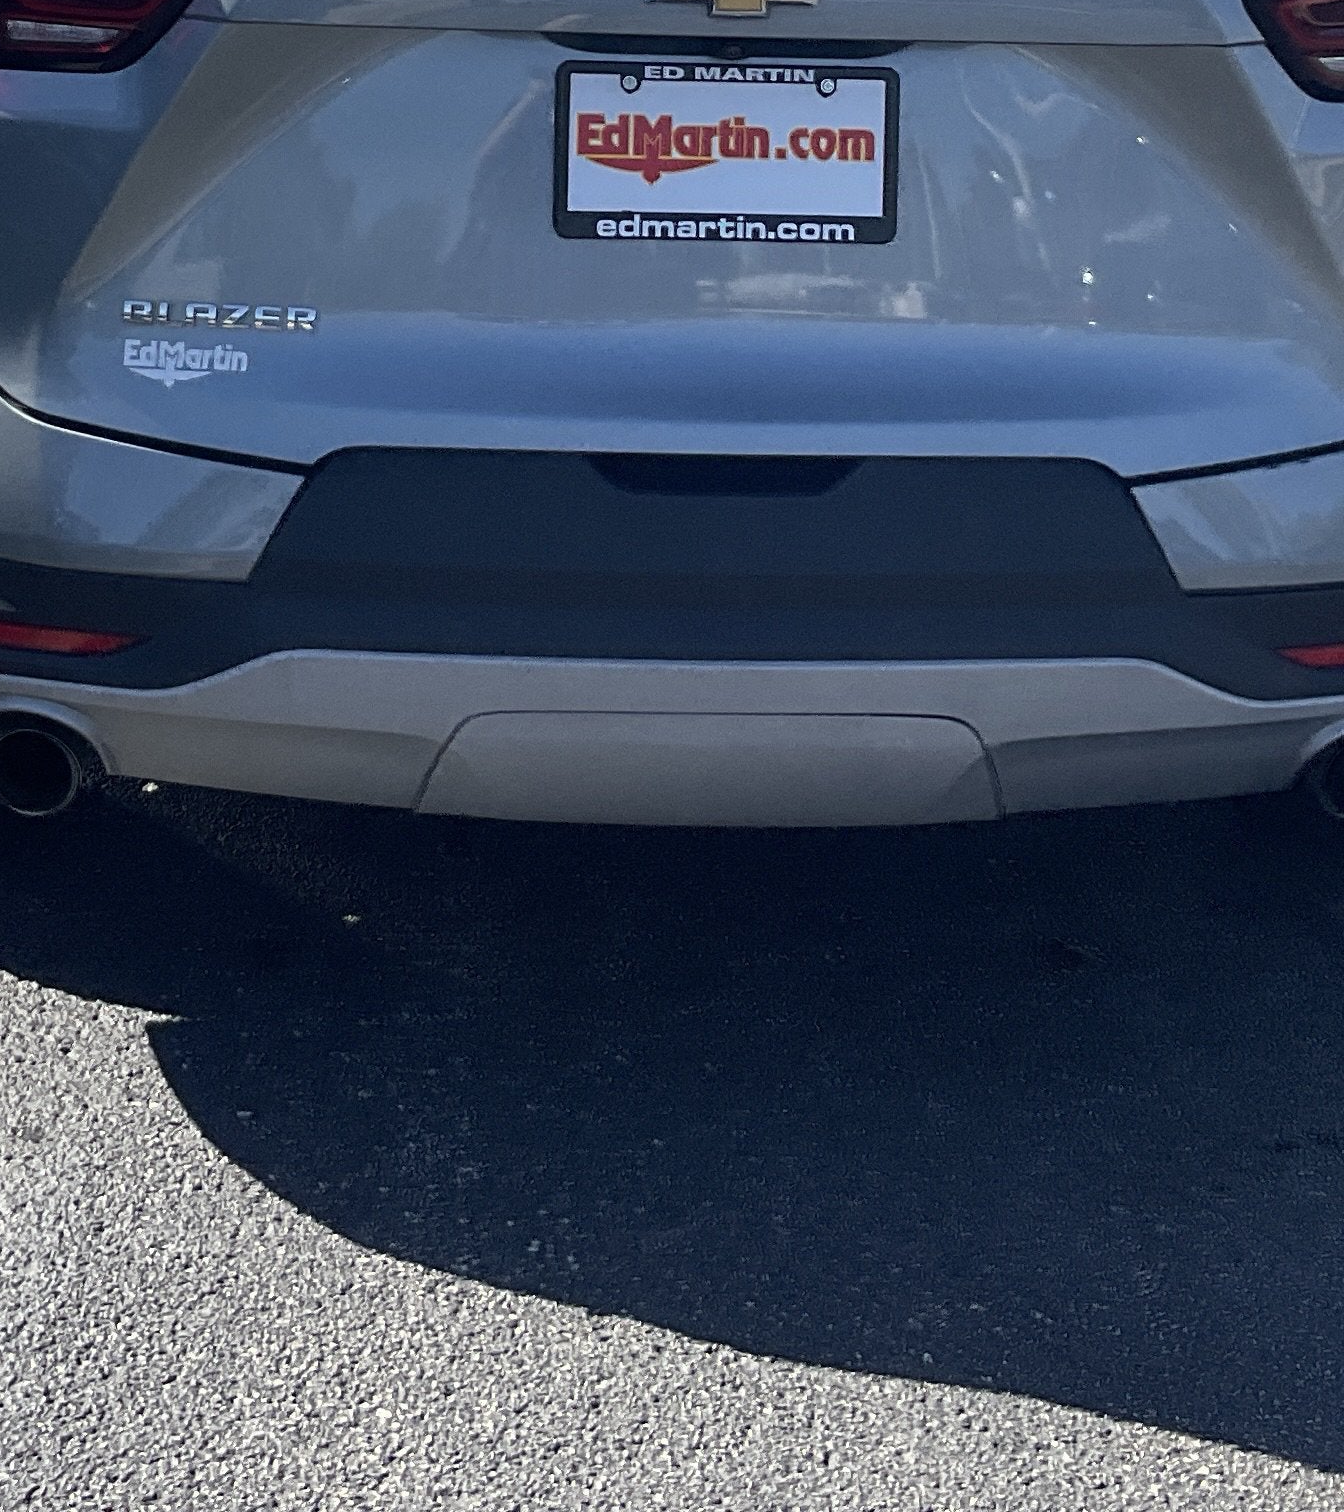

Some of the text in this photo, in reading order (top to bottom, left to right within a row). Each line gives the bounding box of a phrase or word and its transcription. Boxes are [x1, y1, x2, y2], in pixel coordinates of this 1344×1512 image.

[644, 65, 815, 82] ED MARTIN
[576, 112, 875, 162] EdMartin.com
[596, 215, 855, 241] edmartin.com
[122, 300, 318, 330] BLAZER
[122, 339, 248, 372] EdMartin
